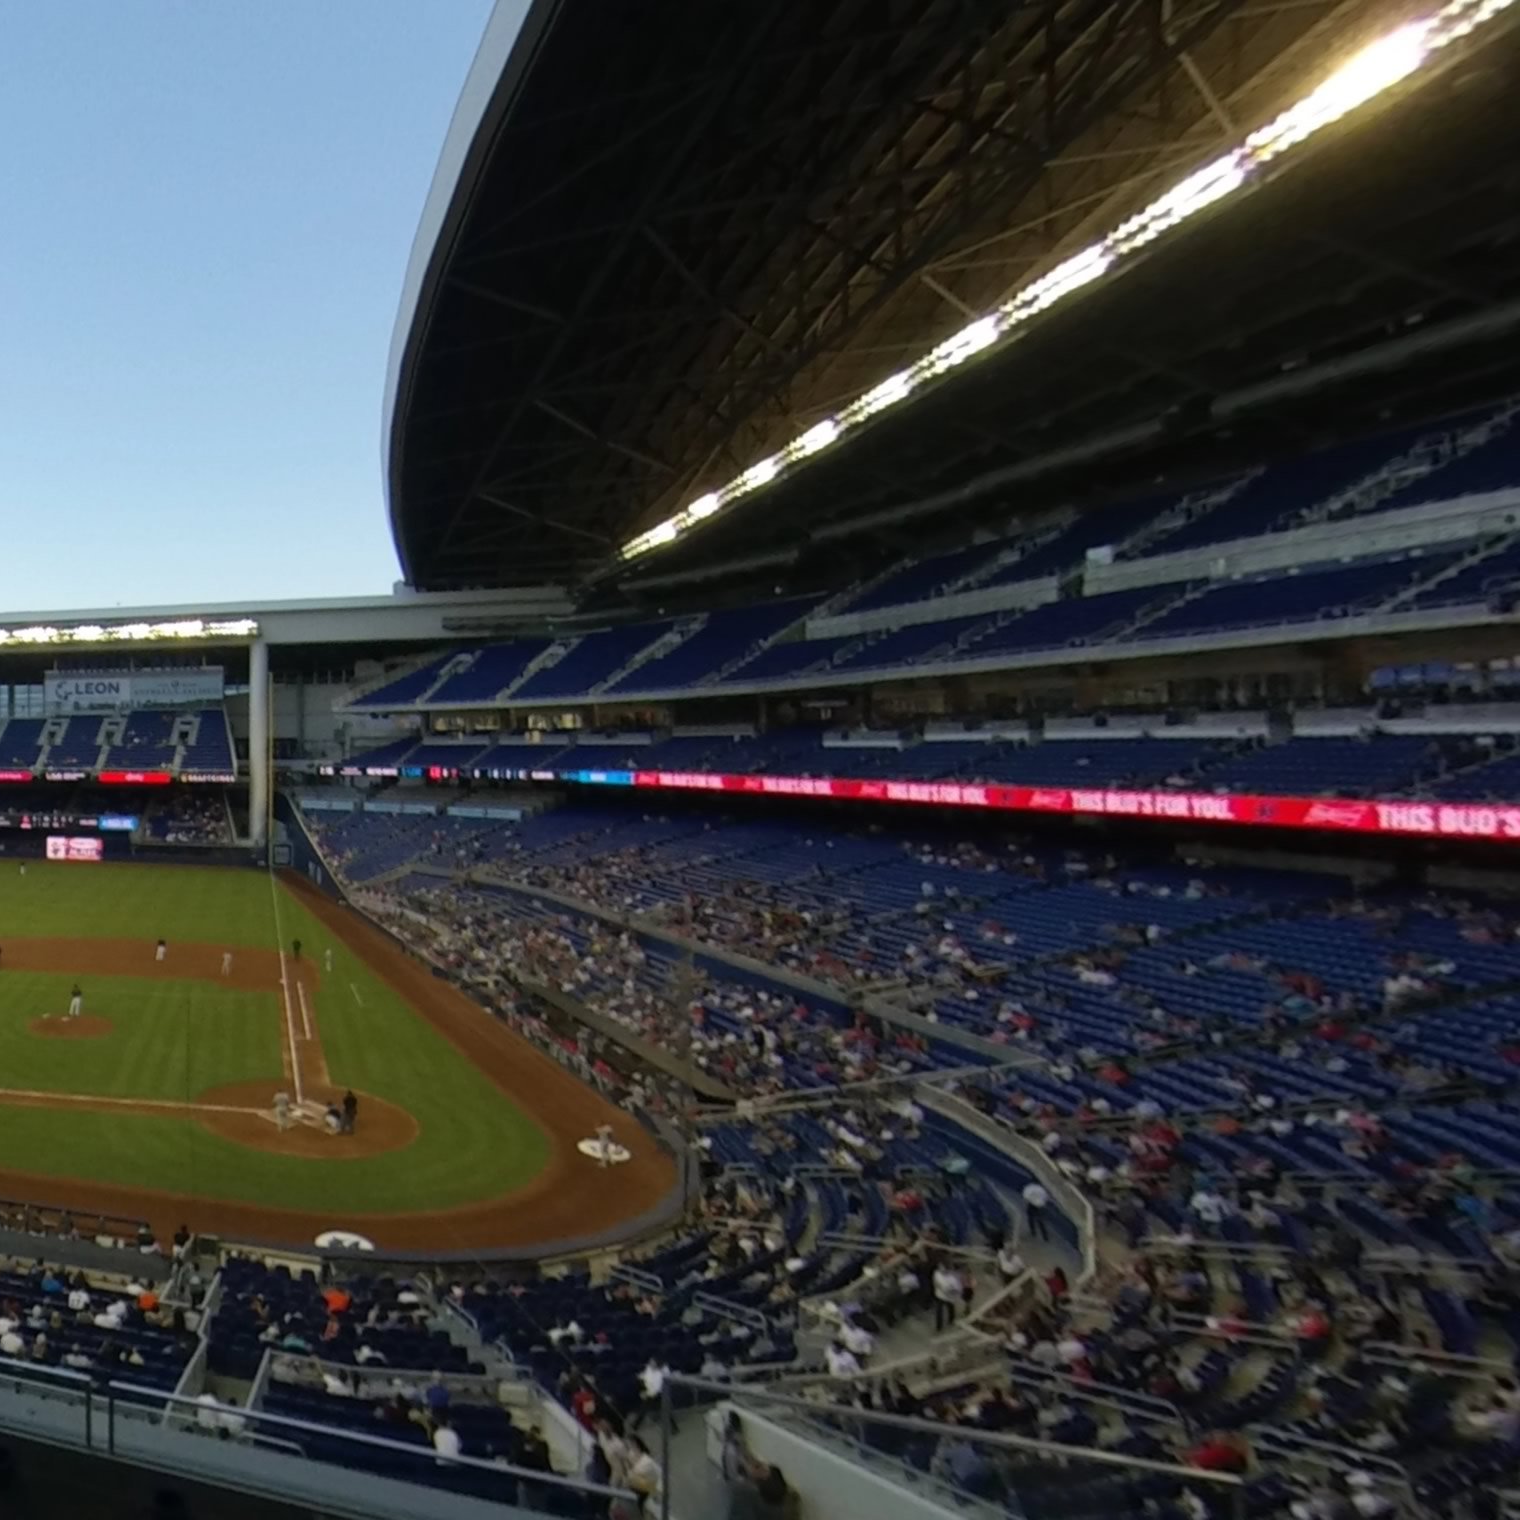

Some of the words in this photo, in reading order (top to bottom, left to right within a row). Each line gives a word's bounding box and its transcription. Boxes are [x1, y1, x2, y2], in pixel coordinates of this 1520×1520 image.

[74, 682, 120, 695] LEON
[887, 783, 907, 800] THIS
[940, 786, 960, 803] FOR
[1072, 792, 1103, 811] THIS
[1105, 793, 1154, 814] BUD'S
[1155, 795, 1189, 816] FOR
[1376, 804, 1434, 832] THIS
